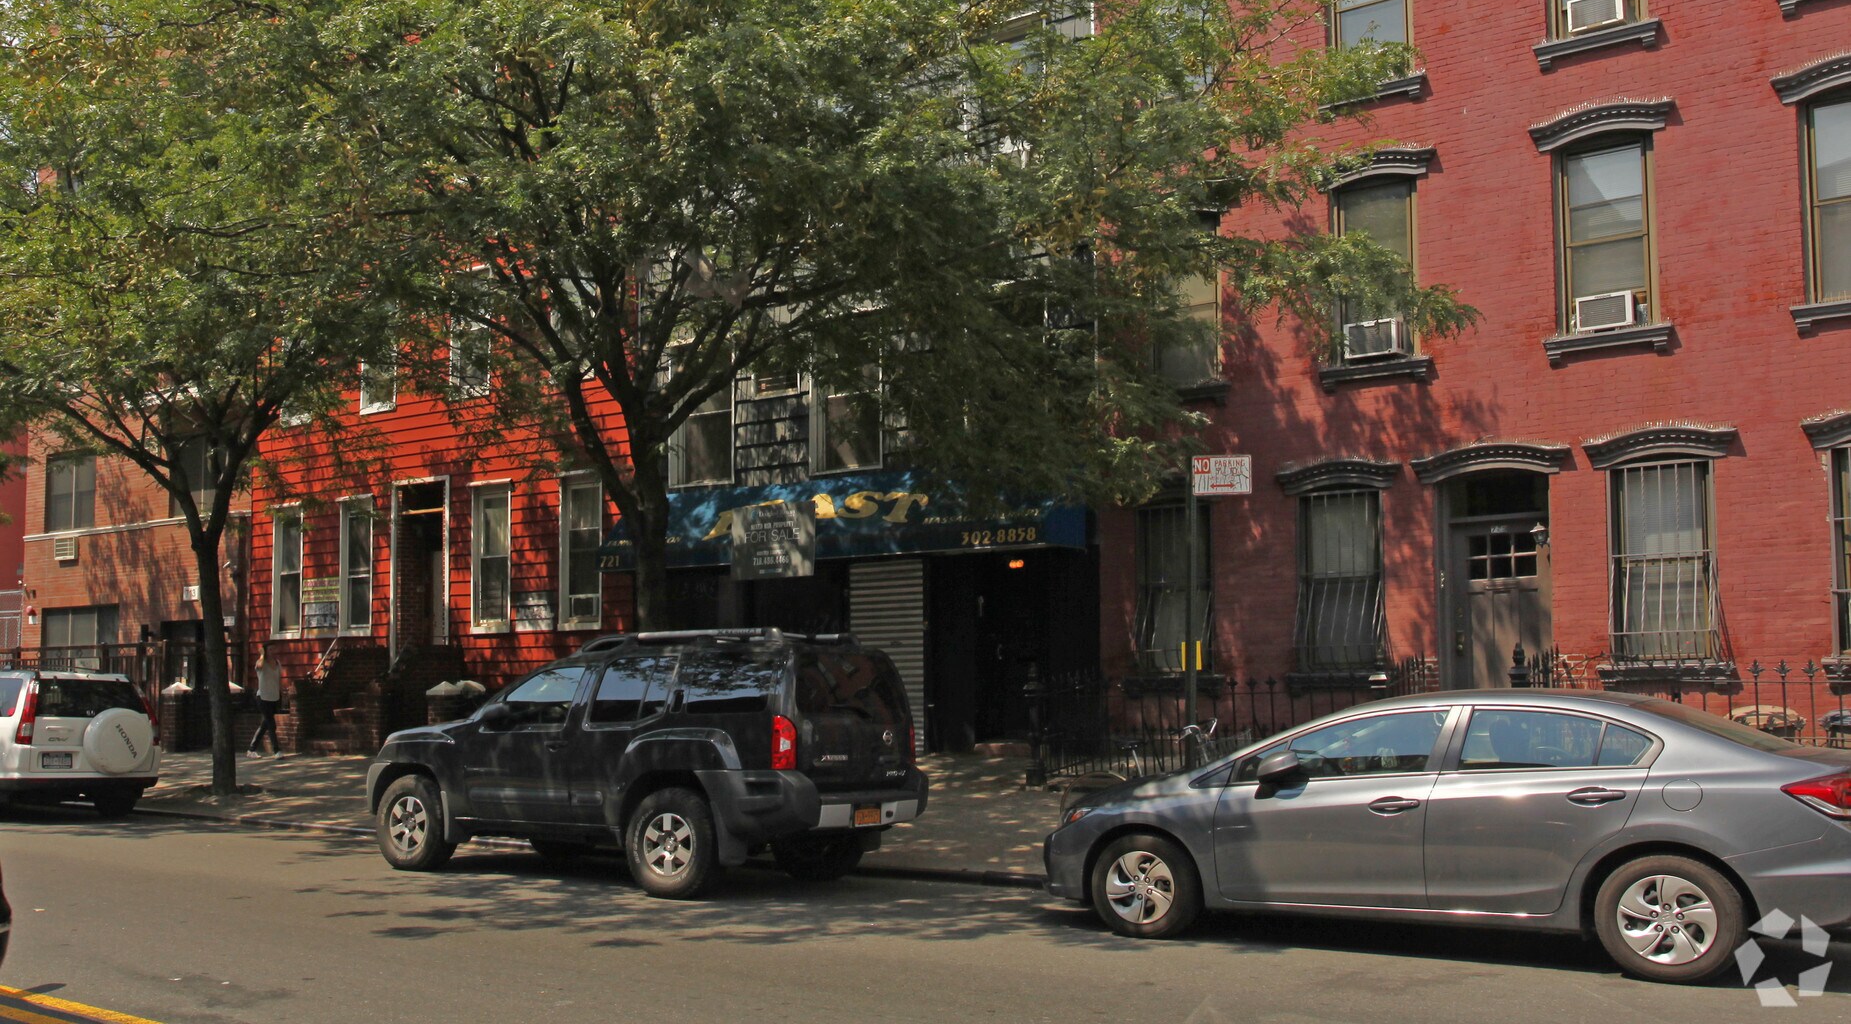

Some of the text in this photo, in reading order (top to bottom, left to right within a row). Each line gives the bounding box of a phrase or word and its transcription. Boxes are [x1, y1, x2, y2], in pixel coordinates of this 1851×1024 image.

[1194, 459, 1210, 473] NO
[1214, 459, 1245, 468] PARKING
[744, 528, 801, 543] FOR SALE
[600, 555, 620, 568] 721
[115, 723, 138, 759] HONDA
